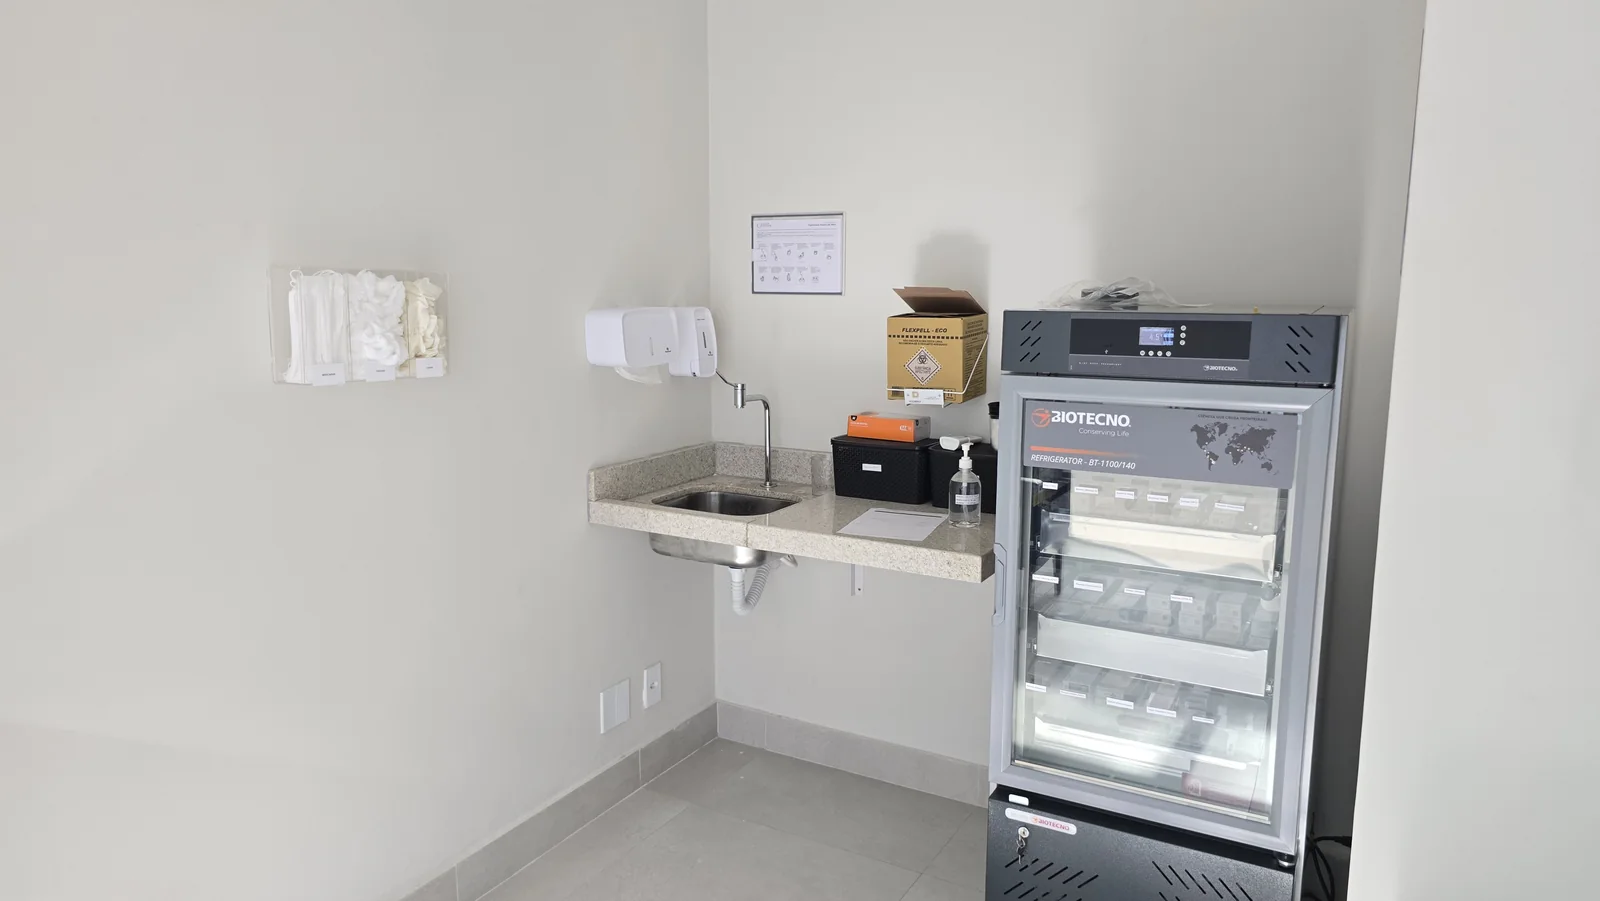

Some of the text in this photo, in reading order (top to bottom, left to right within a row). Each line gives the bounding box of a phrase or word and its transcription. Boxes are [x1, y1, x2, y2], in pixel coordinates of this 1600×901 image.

[1051, 411, 1130, 427] BIOTECNO
[1078, 427, 1130, 438] Conserving Life
[1031, 454, 1083, 465] REFRIGERATOR
[1089, 458, 1136, 470] BT-1100/140
[1038, 818, 1070, 831] BIOTECNO
